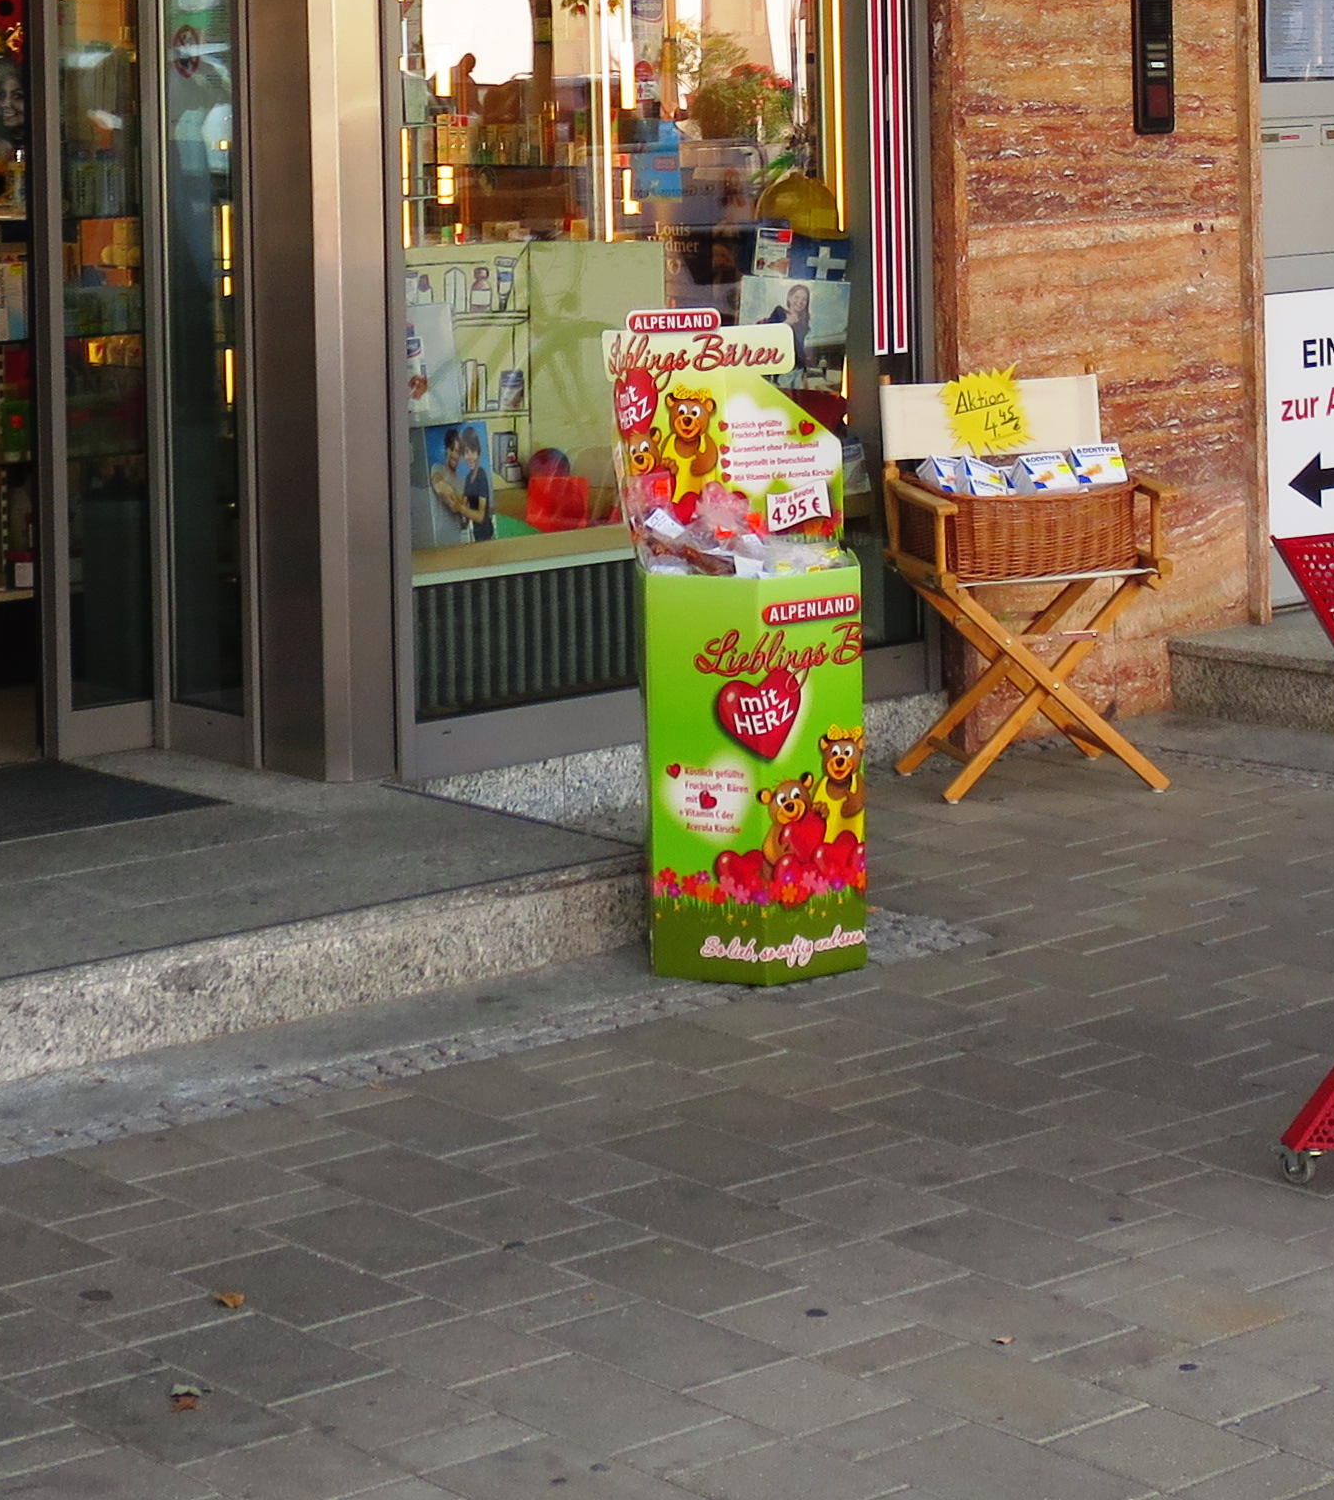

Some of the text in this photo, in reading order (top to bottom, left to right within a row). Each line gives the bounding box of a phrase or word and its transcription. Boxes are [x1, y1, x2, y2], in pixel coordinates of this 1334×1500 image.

[654, 221, 691, 236] Louis
[633, 314, 713, 331] ALPENLAND
[692, 334, 785, 372] Bären
[954, 390, 1007, 416] Aktion
[1281, 396, 1319, 422] zur
[771, 496, 822, 525] 4.95 €
[769, 596, 855, 623] ALPENLAND
[693, 629, 828, 693] Lieblings
[740, 687, 780, 713] mit
[733, 698, 794, 736] HERZ
